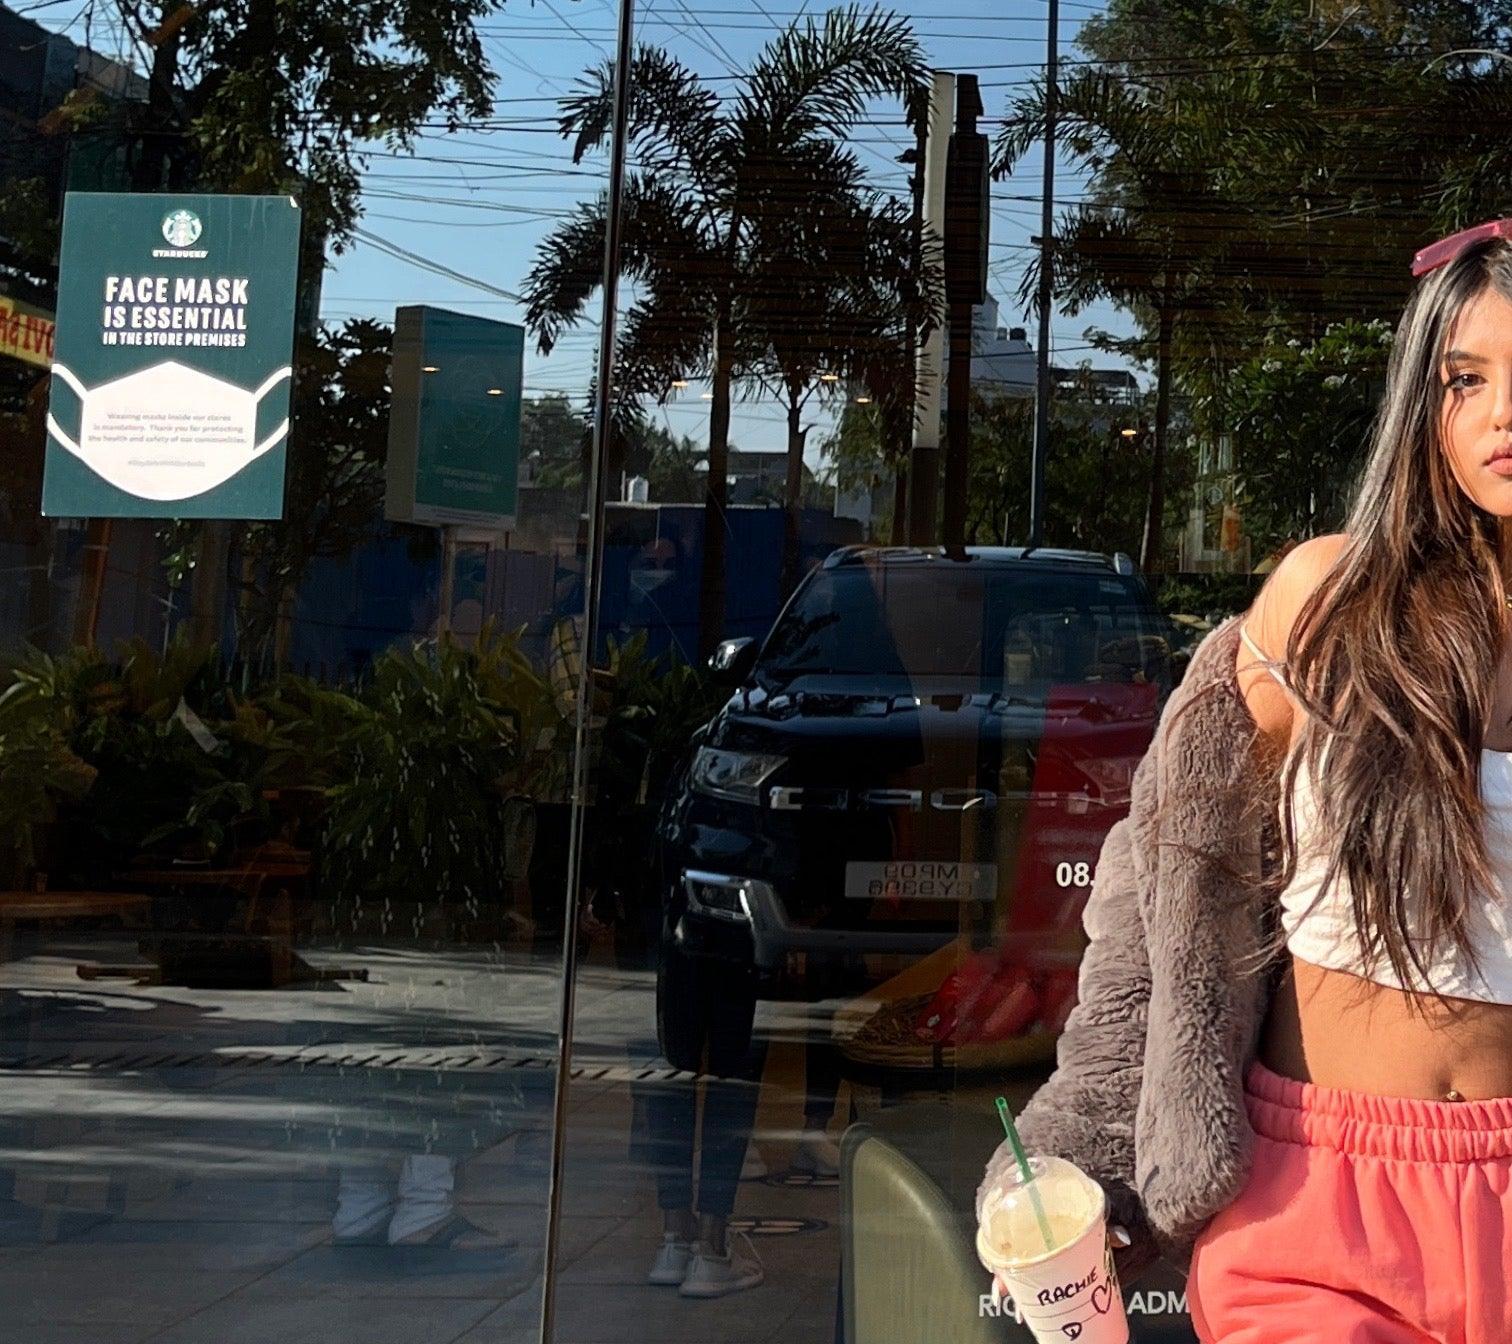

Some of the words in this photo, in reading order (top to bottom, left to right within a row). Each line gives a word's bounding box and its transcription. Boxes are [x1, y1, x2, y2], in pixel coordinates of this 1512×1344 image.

[105, 276, 169, 303] FACE
[174, 277, 249, 305] MASK
[103, 306, 126, 328] IS
[131, 306, 247, 330] ESSENTIAL
[102, 332, 117, 345] IN
[119, 332, 142, 346] THE
[144, 332, 183, 346] STORE
[184, 332, 246, 347] PREMISES
[1056, 861, 1094, 887] 08.
[1037, 1265, 1099, 1306] RACHIE
[979, 1294, 1015, 1317] RIG
[1126, 1290, 1192, 1315] ADM
